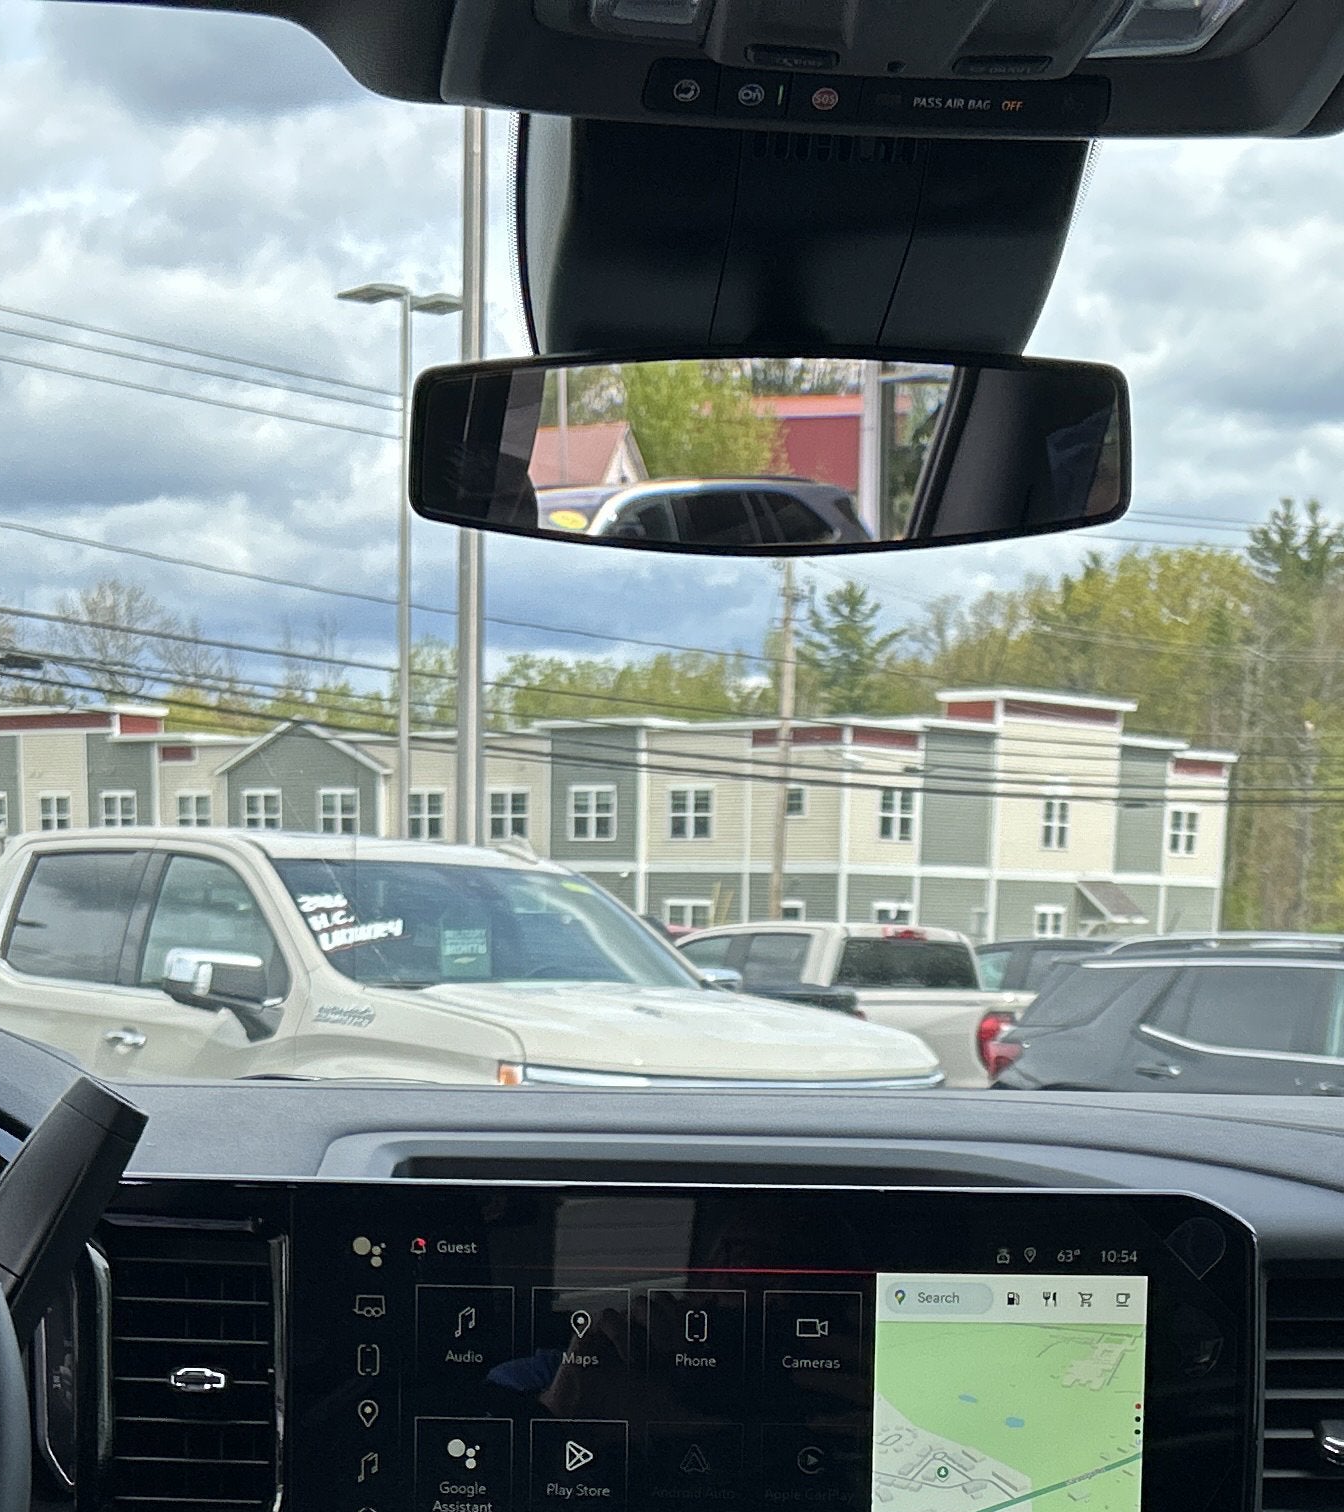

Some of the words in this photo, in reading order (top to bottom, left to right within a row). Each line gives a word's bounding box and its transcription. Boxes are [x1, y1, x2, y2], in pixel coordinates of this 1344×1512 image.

[814, 93, 836, 105] SOS
[912, 96, 943, 109] PASS
[945, 97, 964, 109] AIR
[967, 98, 991, 111] BAG
[1001, 100, 1024, 111] OFF
[436, 1240, 478, 1255] Guest
[1100, 1250, 1138, 1263] 10:54
[917, 1291, 960, 1305] Search
[444, 1350, 484, 1364] Audio
[561, 1353, 599, 1368] Maps
[675, 1354, 717, 1369] Phone
[782, 1356, 841, 1370] Cameras
[439, 1482, 487, 1498] Google
[546, 1483, 575, 1498] Play
[577, 1483, 611, 1498] Store
